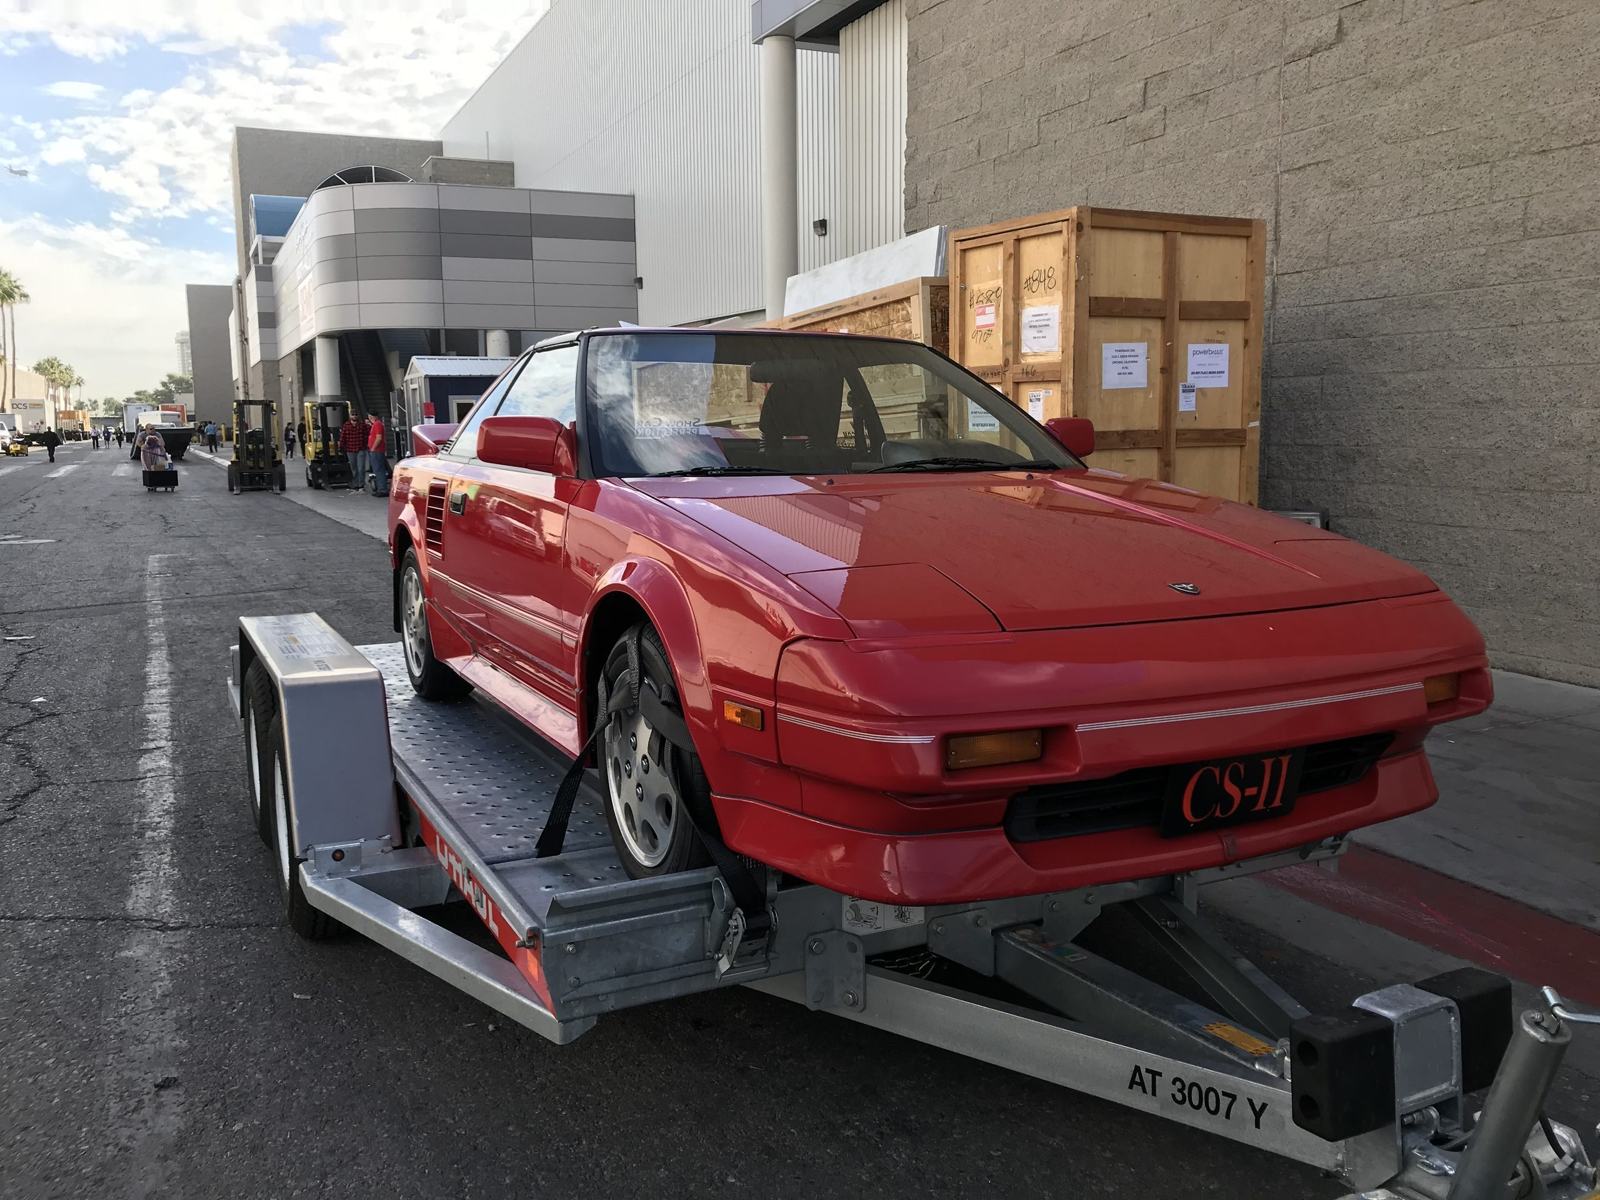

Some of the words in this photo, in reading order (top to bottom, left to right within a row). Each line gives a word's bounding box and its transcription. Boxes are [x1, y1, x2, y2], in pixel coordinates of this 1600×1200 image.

[1023, 266, 1057, 294] #848
[1182, 753, 1292, 822] CS-II
[1128, 1064, 1163, 1097] AT
[1170, 1076, 1238, 1120] 3007
[1246, 1096, 1269, 1130] Y
